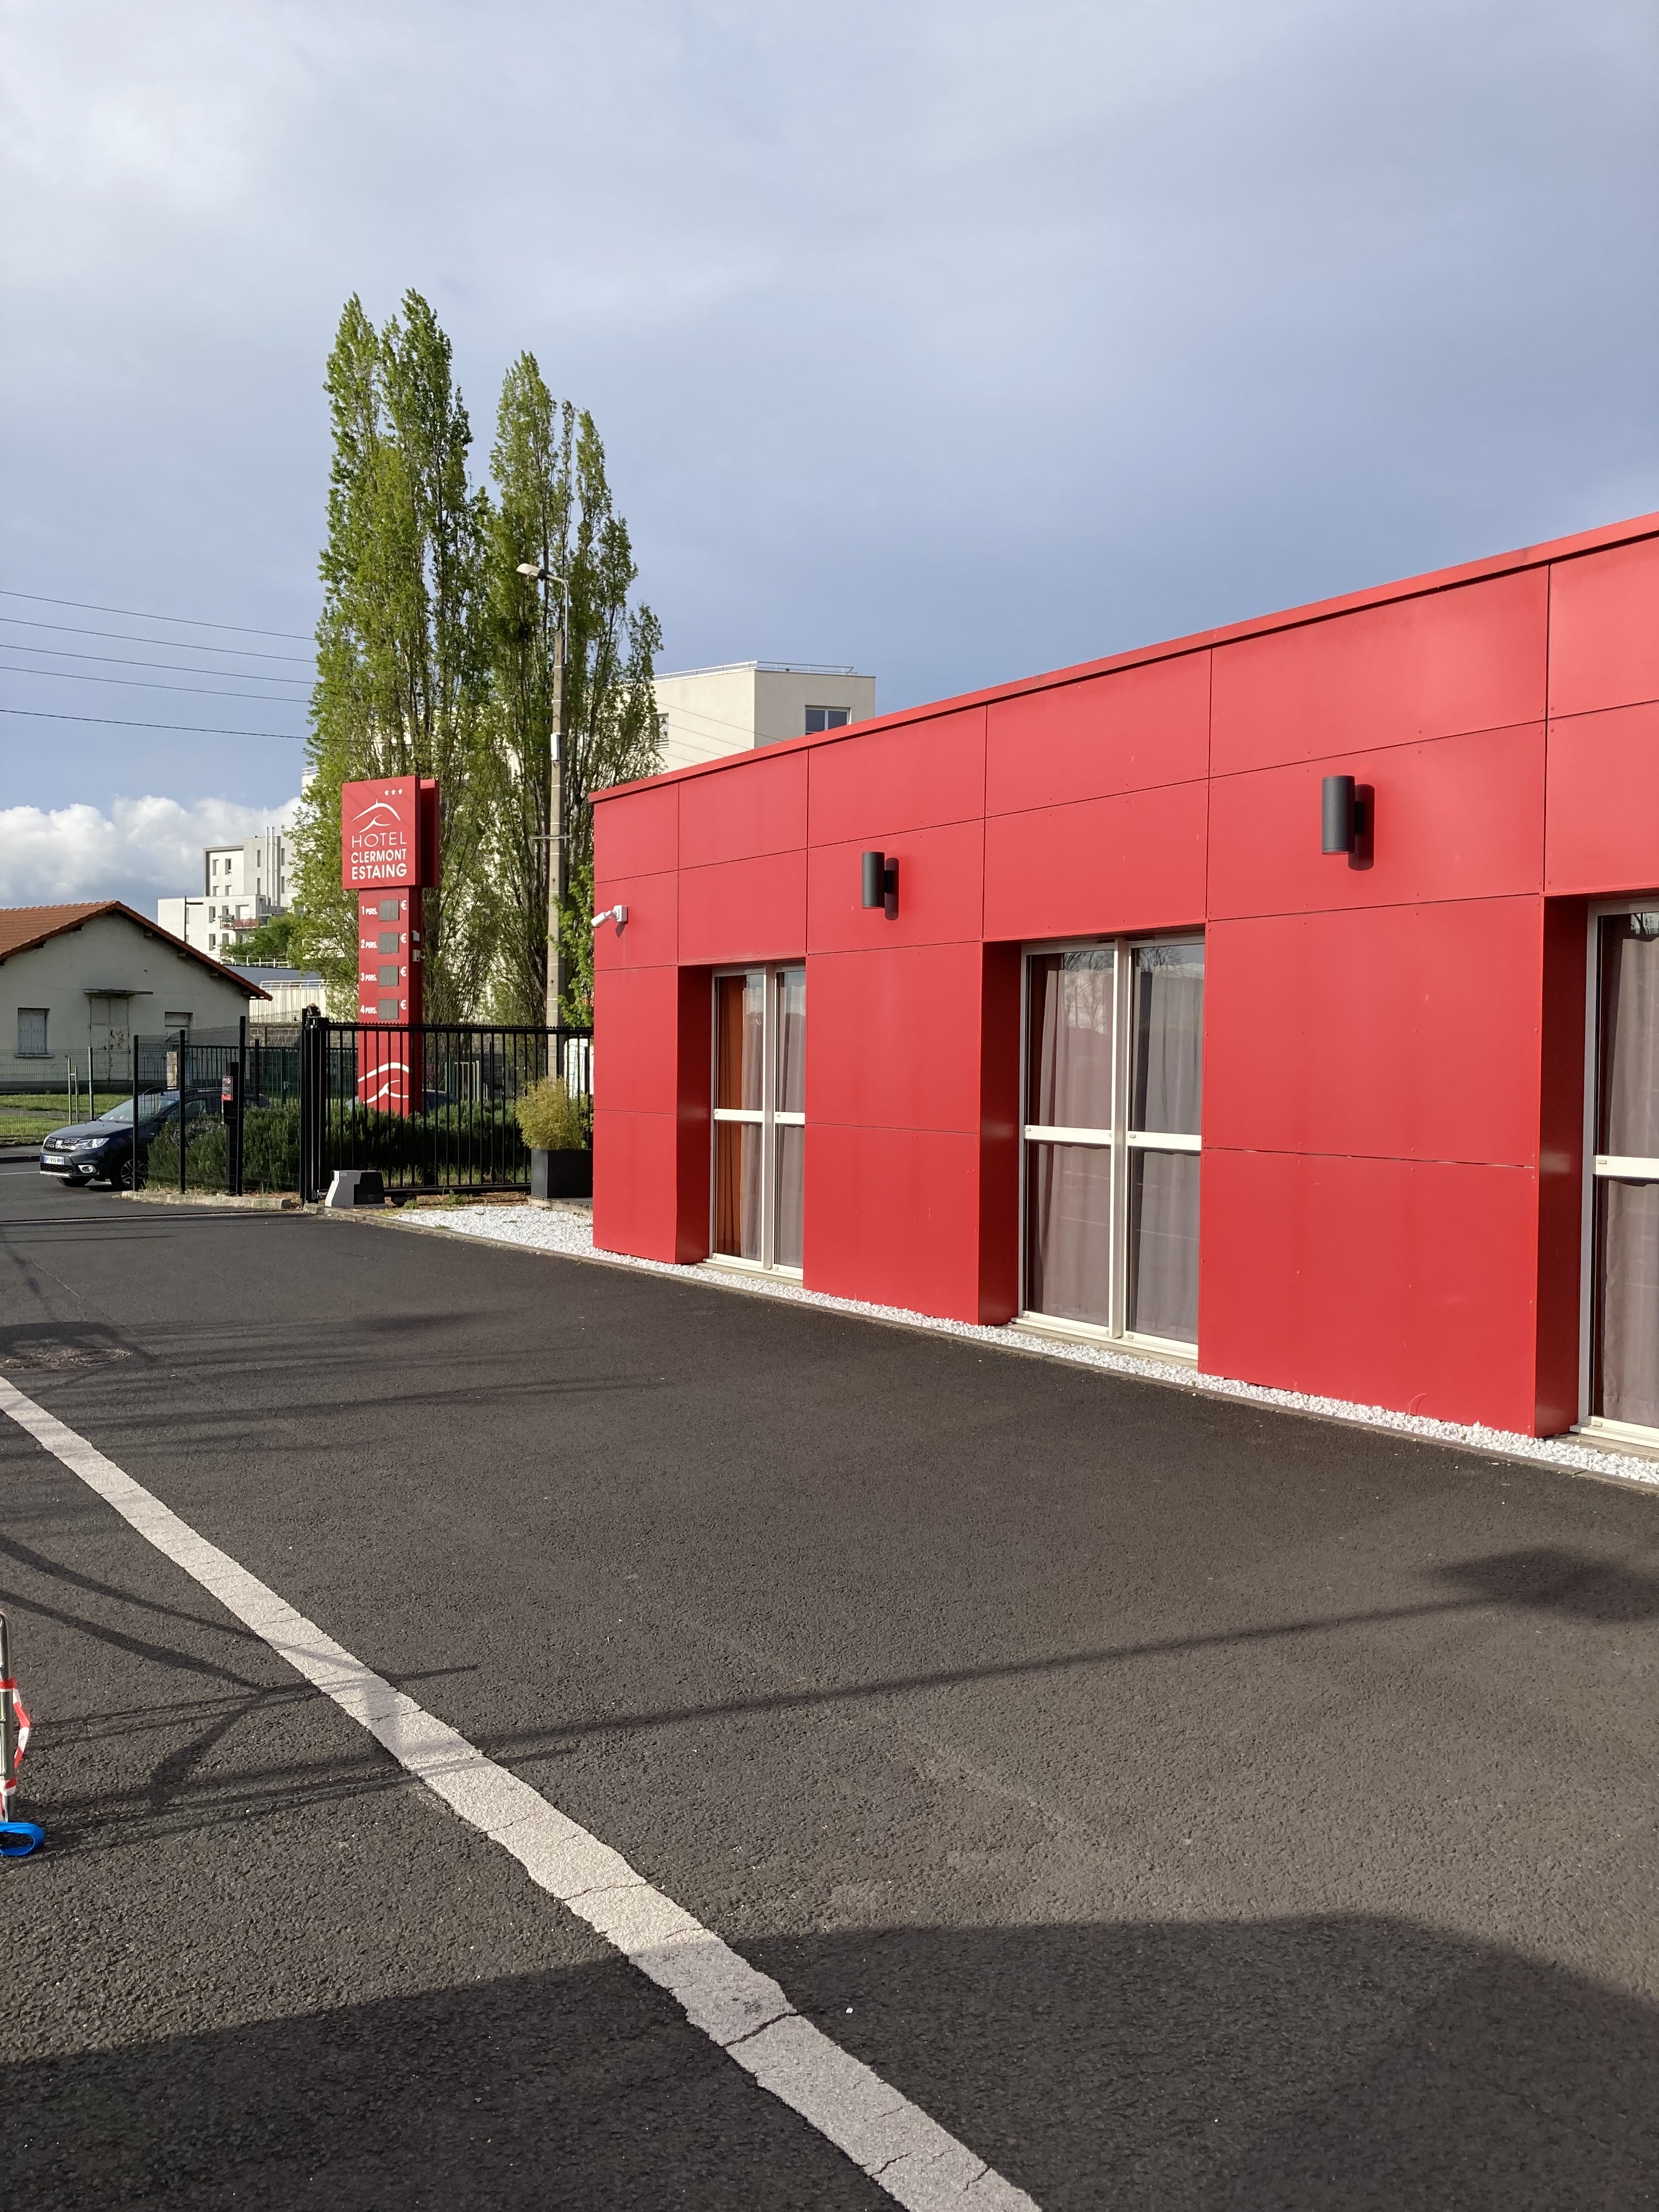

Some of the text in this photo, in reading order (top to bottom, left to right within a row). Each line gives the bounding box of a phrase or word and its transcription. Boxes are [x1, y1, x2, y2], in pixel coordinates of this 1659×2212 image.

[351, 849, 407, 864] CLERMONT
[351, 863, 407, 880] ESTAING
[361, 906, 365, 915] 1
[400, 900, 407, 910] €
[360, 939, 365, 949] 2
[400, 933, 407, 944] €
[360, 972, 365, 981] 3
[400, 966, 407, 977] €
[360, 1005, 365, 1014] 4
[400, 1000, 407, 1009] €
